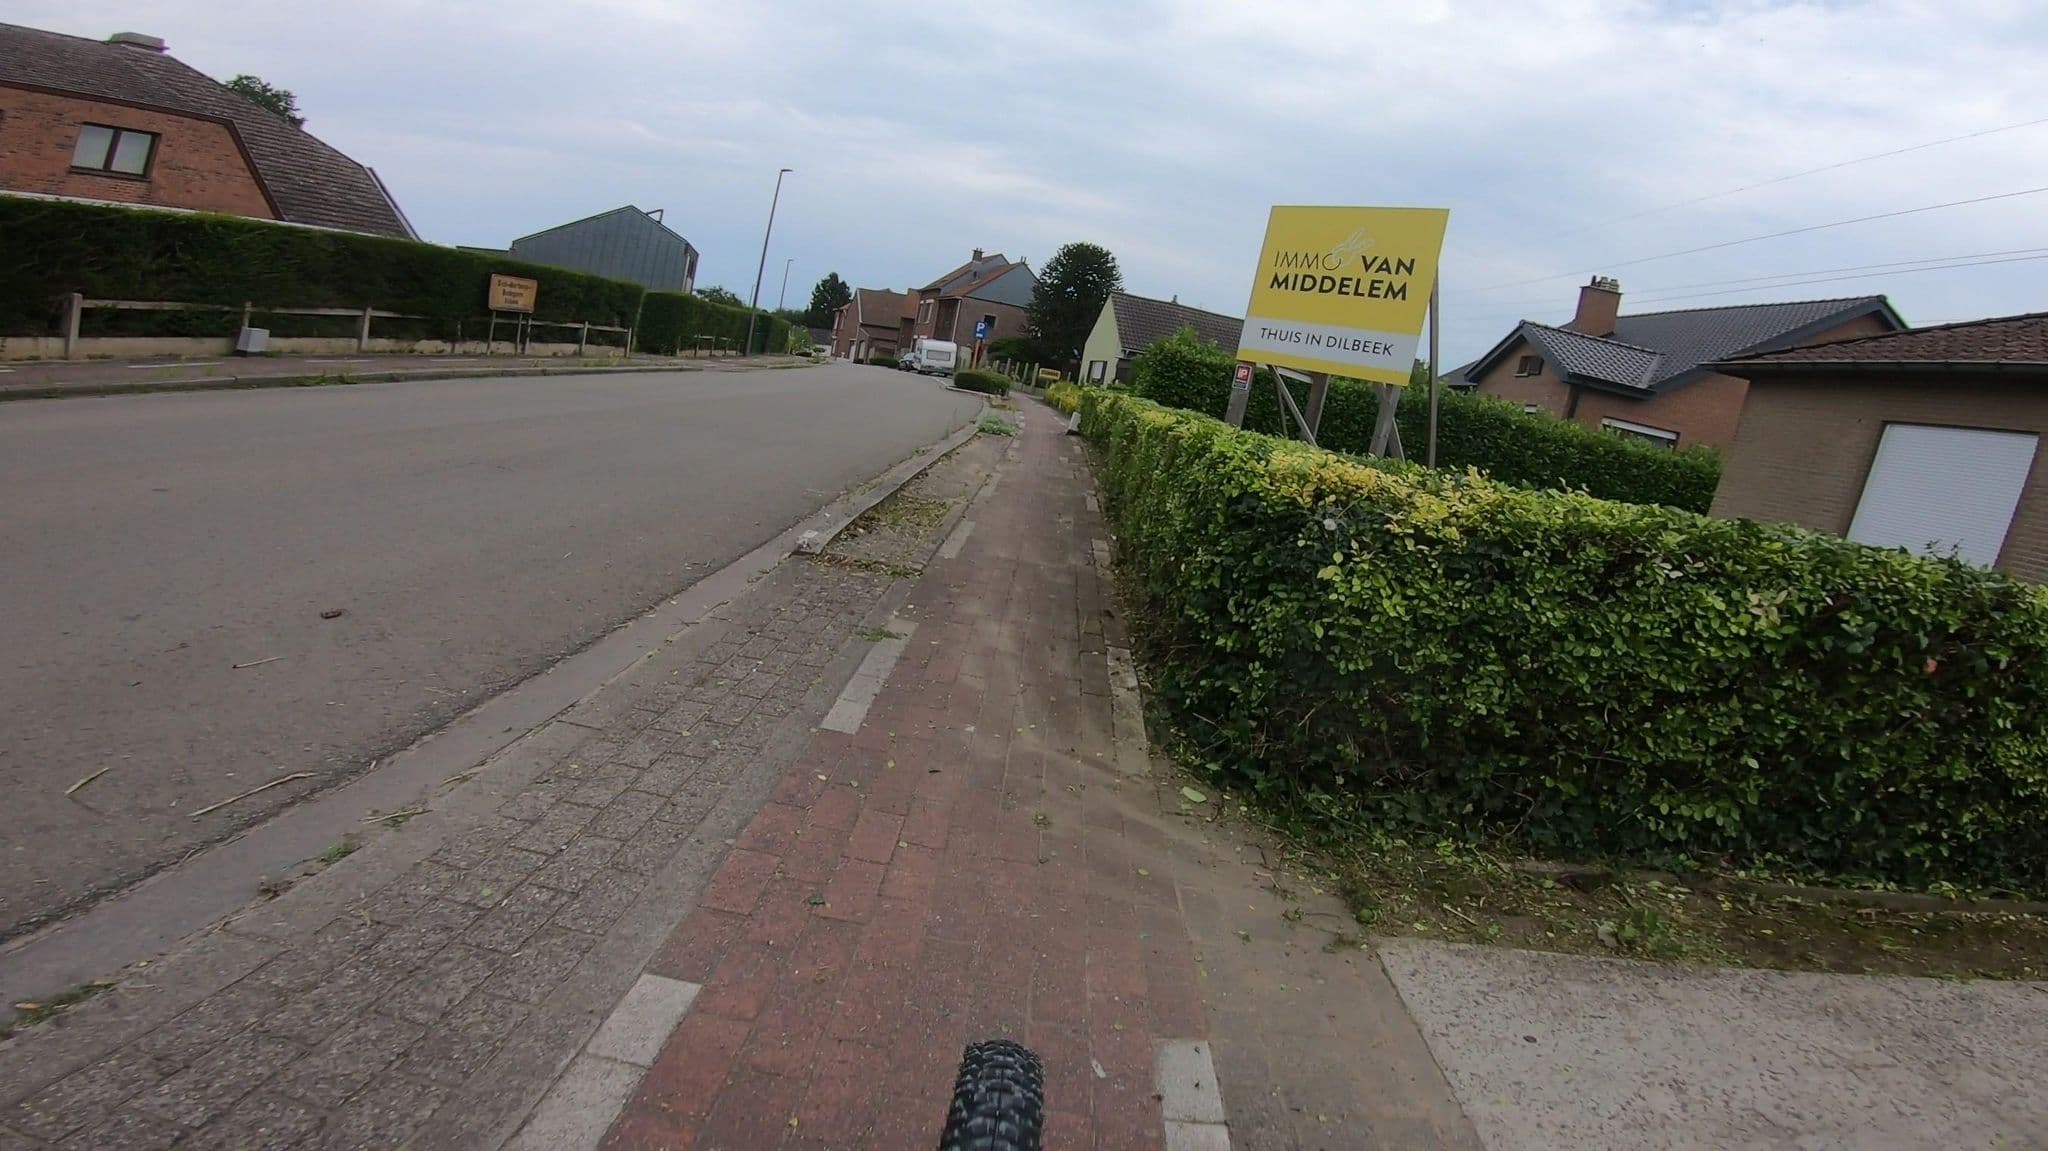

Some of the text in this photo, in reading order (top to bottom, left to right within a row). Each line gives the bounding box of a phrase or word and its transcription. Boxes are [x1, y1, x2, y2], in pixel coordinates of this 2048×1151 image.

[1274, 251, 1415, 276] IMMO VAN
[1270, 272, 1408, 301] MIDDELEM
[976, 322, 986, 332] P
[1260, 327, 1394, 356] THUIS IN DILBEEK
